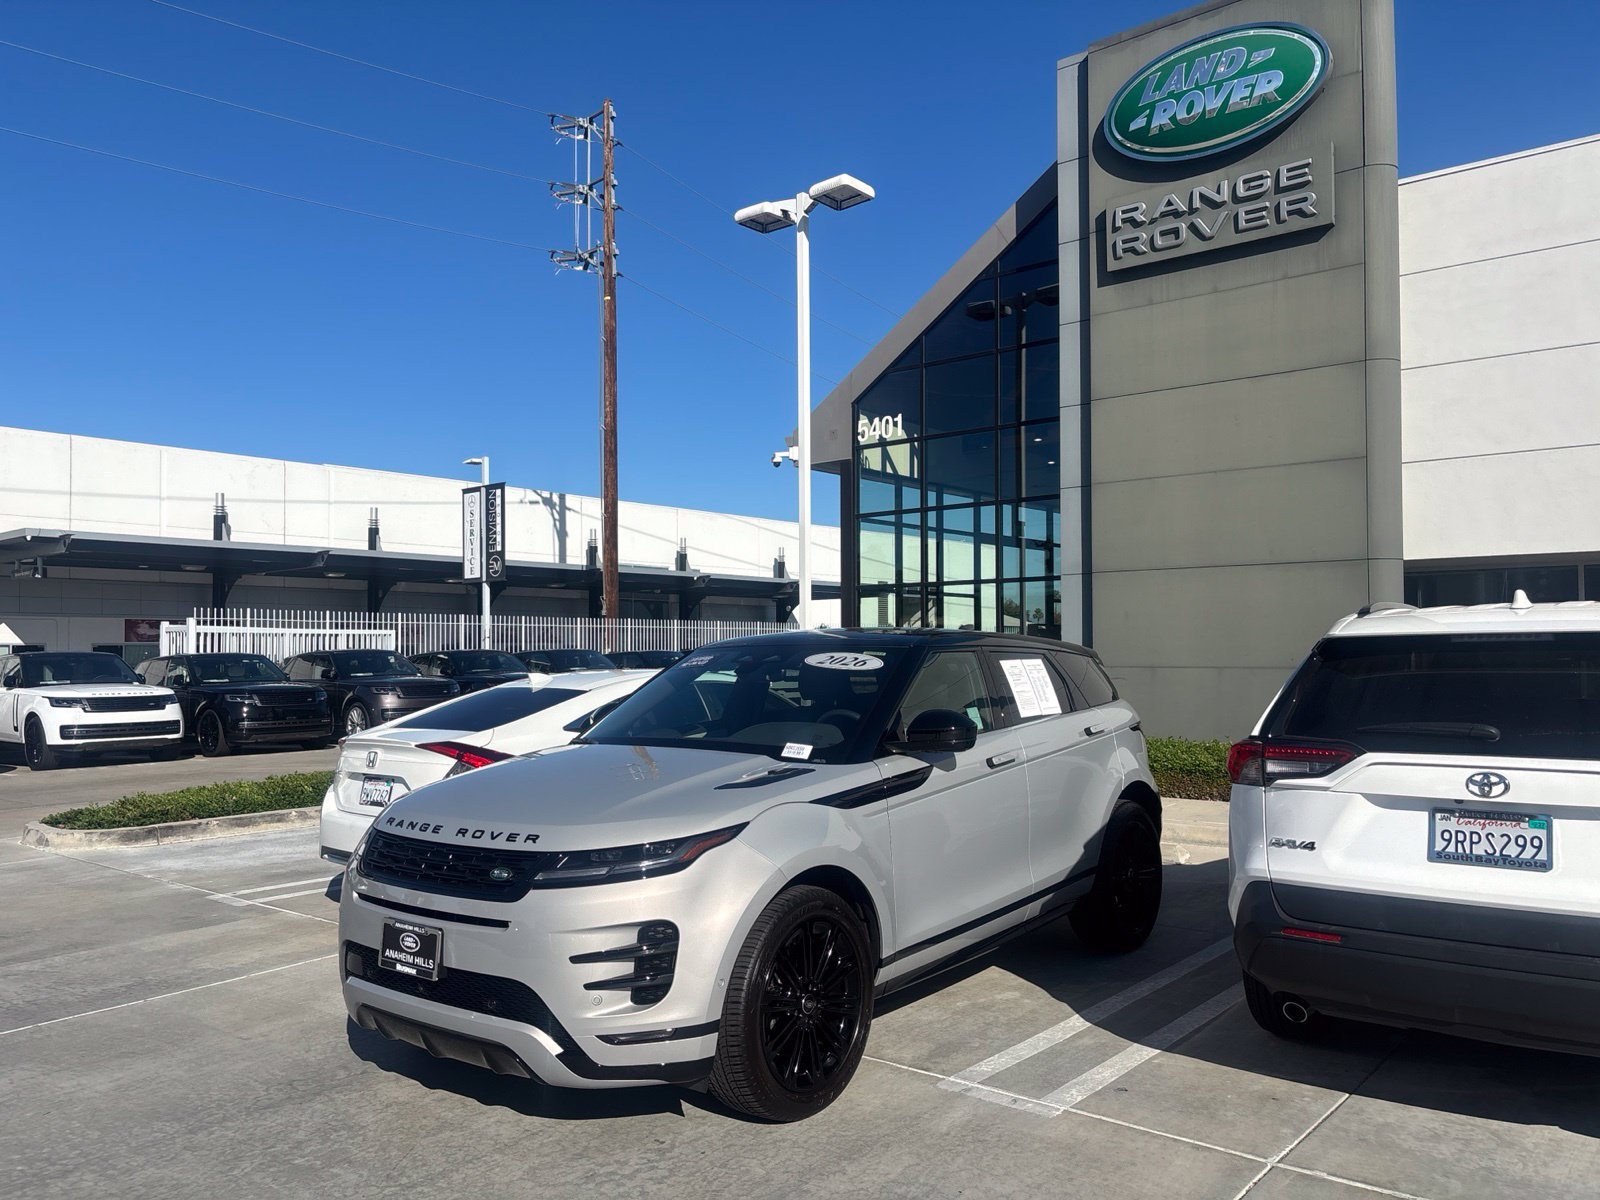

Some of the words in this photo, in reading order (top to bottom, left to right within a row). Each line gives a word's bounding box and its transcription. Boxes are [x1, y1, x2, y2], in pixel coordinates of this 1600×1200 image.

[1139, 46, 1247, 107] LAND
[1148, 70, 1284, 136] ROVER
[1115, 157, 1313, 227] RANGE
[1114, 191, 1318, 260] ROVER
[857, 413, 903, 442] 5401
[488, 489, 497, 552] ENVISION
[816, 655, 869, 668] 2026
[386, 816, 444, 834] RANGE
[455, 827, 540, 844] ROVER
[1438, 814, 1452, 822] JAN
[1455, 816, 1528, 830] California
[1440, 828, 1544, 859] 9RPS299
[385, 948, 414, 964] ANAHEIM
[414, 956, 434, 969] HILLS
